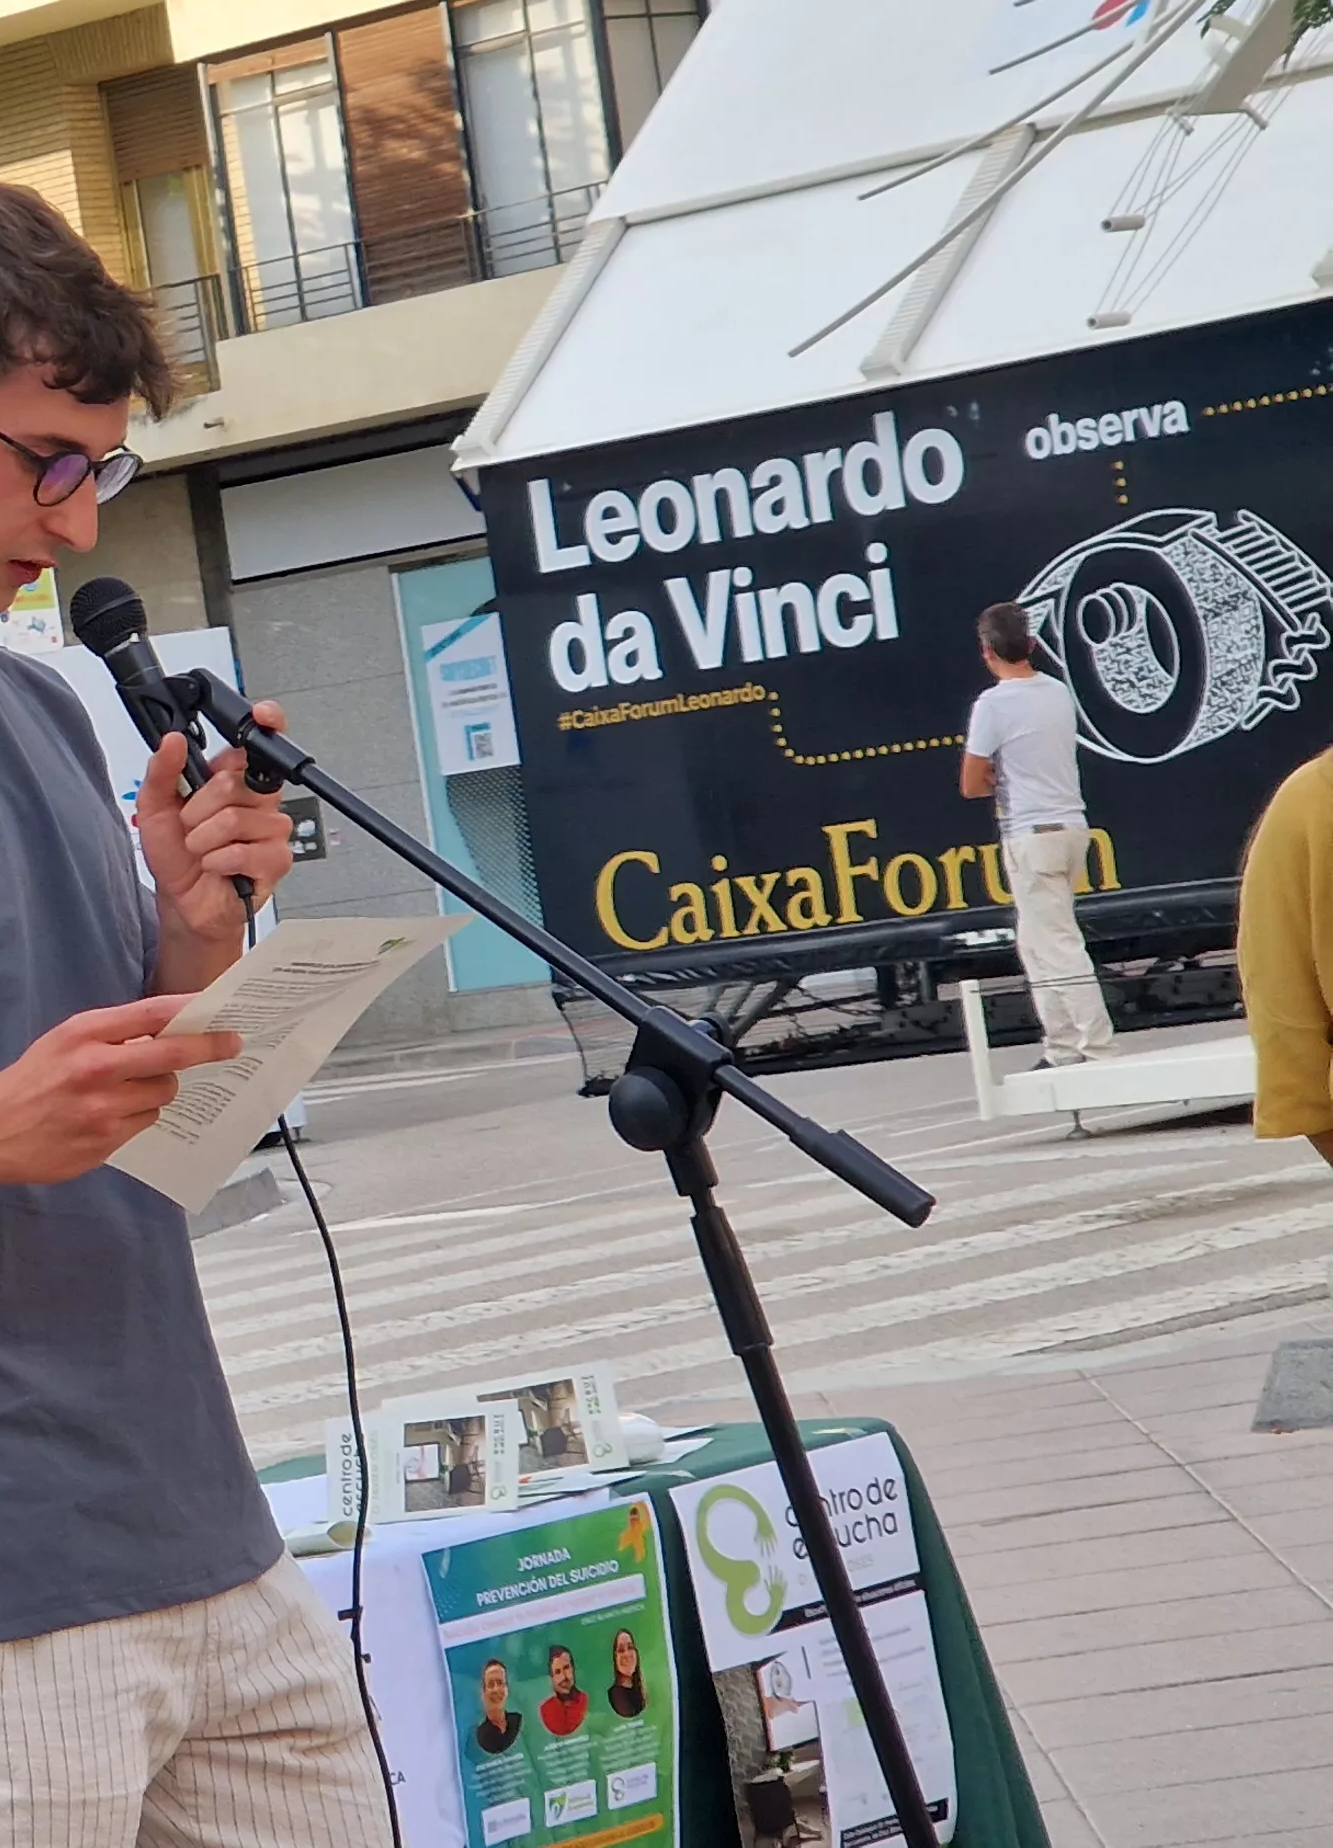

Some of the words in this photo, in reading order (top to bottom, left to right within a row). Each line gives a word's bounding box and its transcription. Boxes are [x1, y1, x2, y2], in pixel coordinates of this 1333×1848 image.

[1025, 400, 1190, 460] observa
[527, 410, 965, 575] Leonardo
[548, 593, 663, 693] da
[664, 541, 900, 671] Vinci
[557, 682, 767, 731] #CaixaForumLeonardo
[340, 1433, 352, 1457] de
[341, 1458, 354, 1517] centro
[785, 1488, 864, 1528] cntro
[866, 1476, 899, 1506] de
[517, 1547, 571, 1572] JORNADA
[792, 1511, 900, 1560] eucha
[475, 1575, 548, 1607] PREVENCIÓN
[549, 1572, 569, 1588] DEL
[571, 1560, 620, 1584] SUICIDIO
